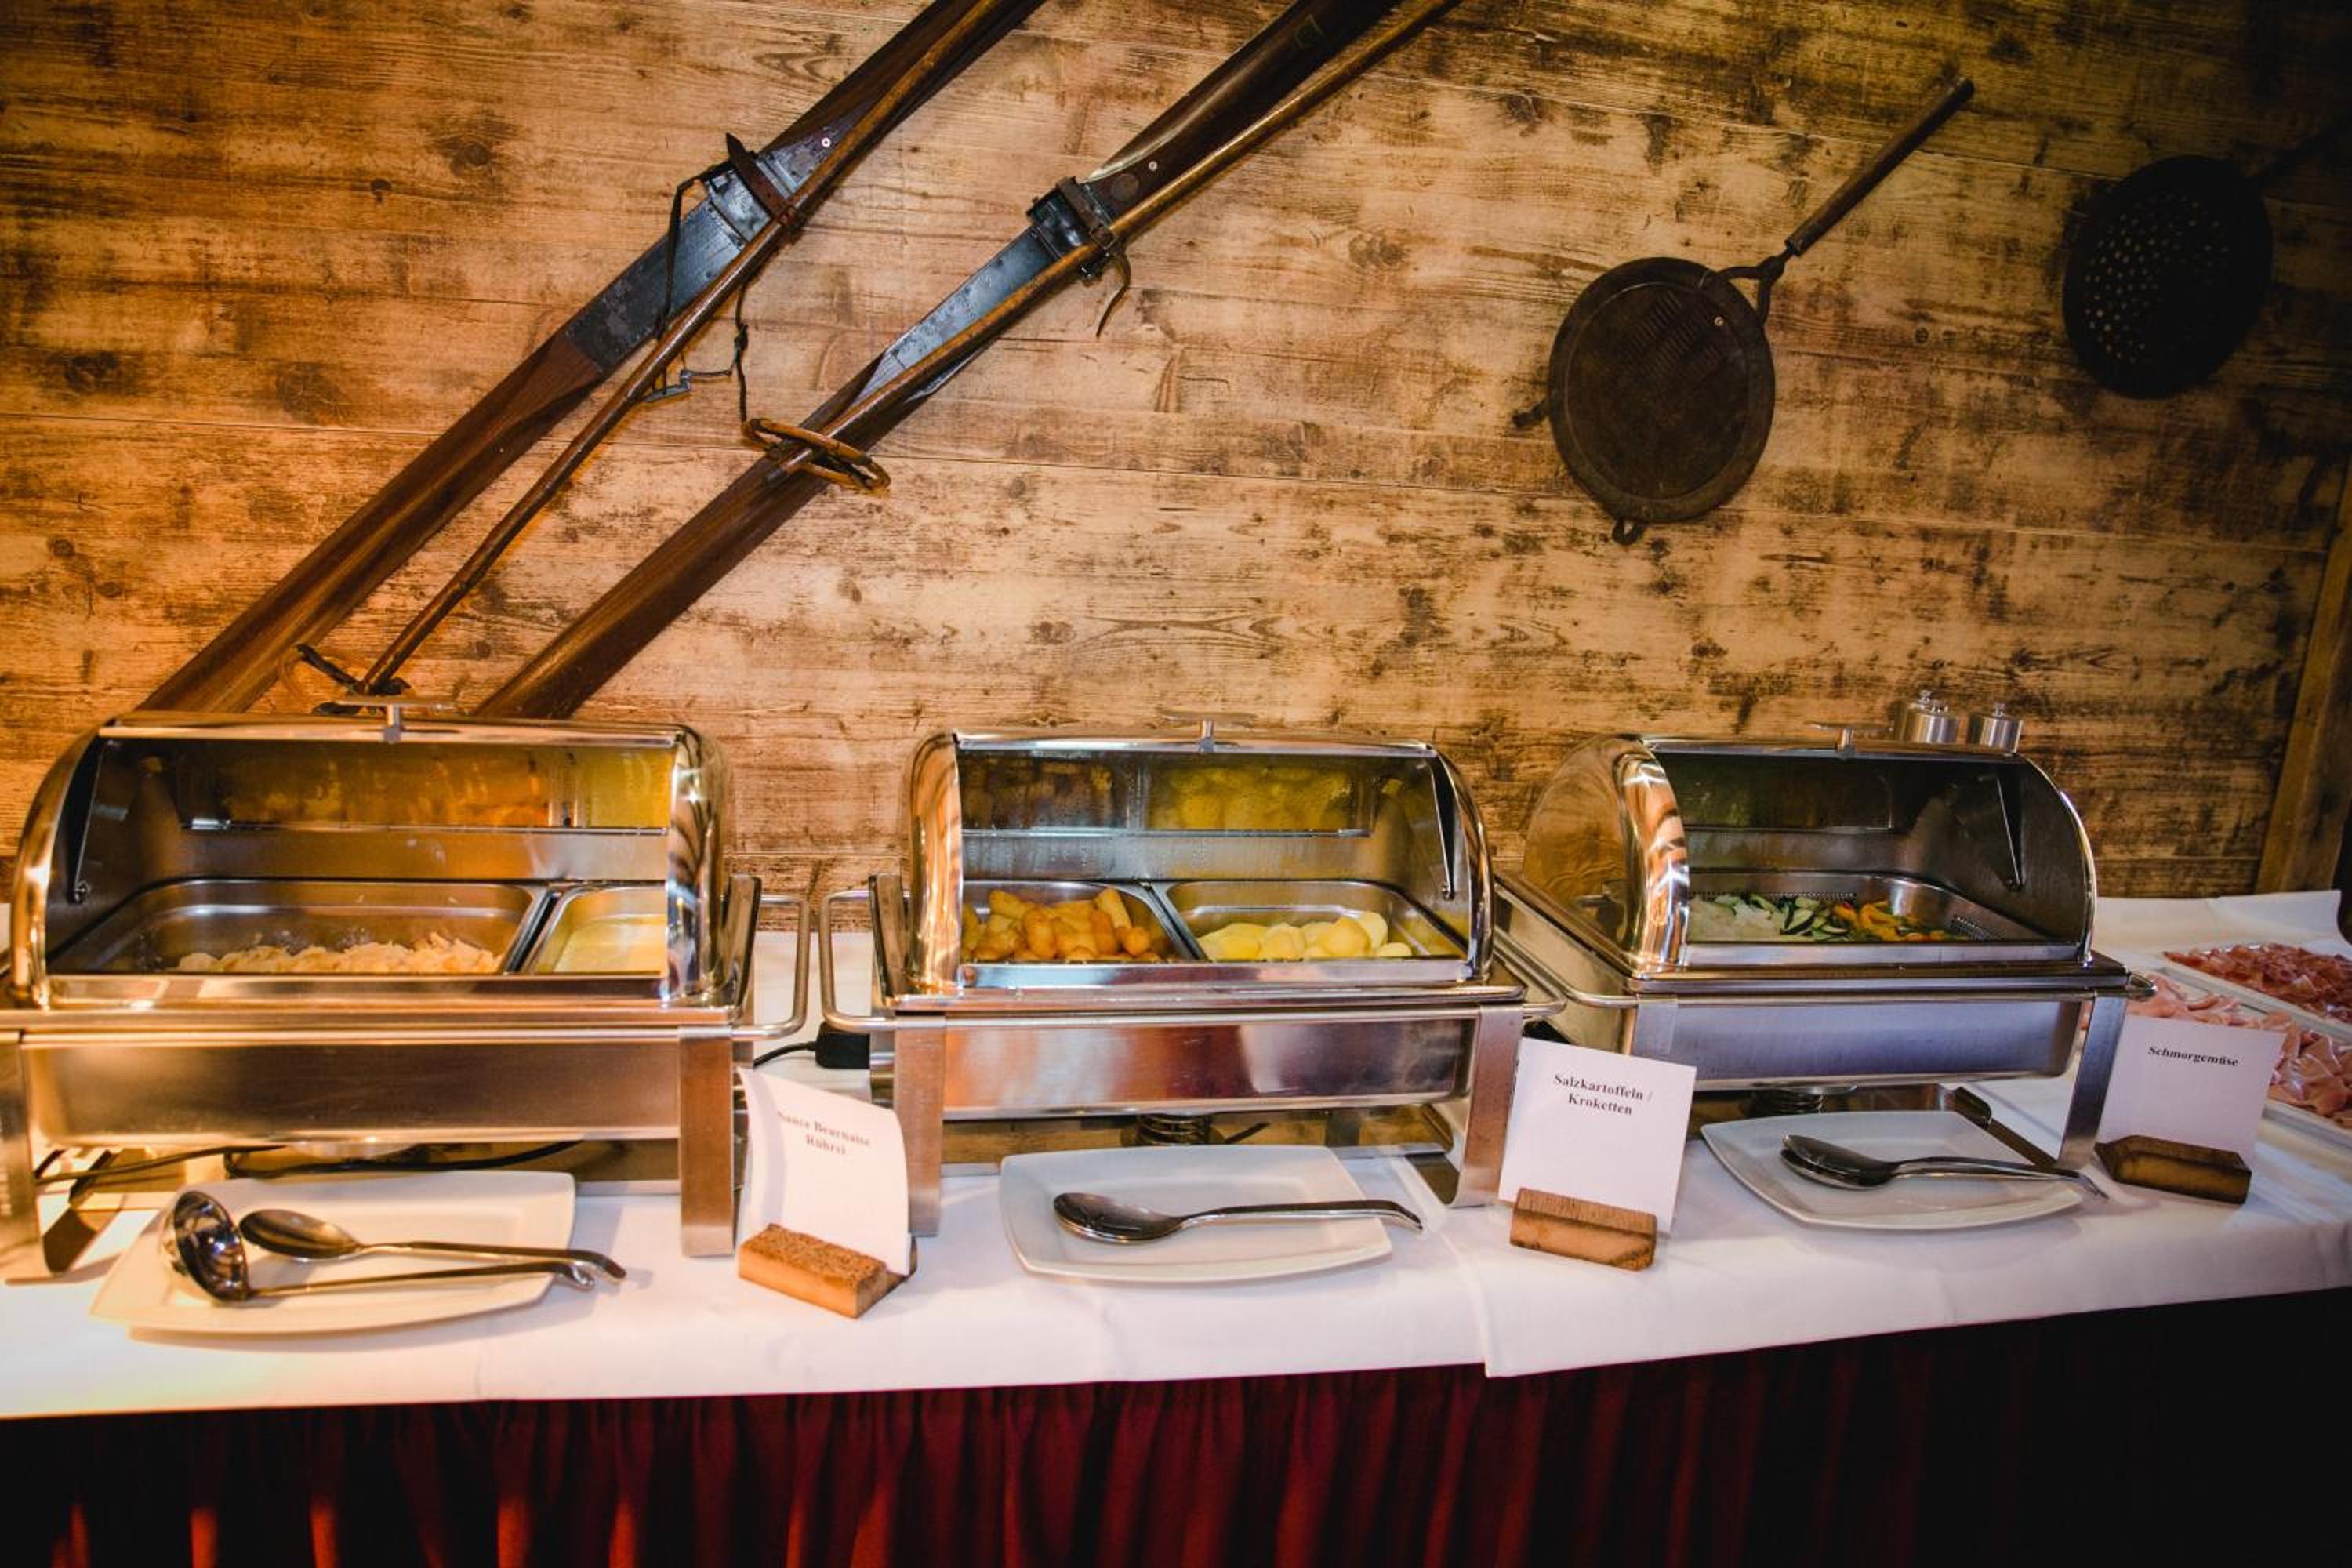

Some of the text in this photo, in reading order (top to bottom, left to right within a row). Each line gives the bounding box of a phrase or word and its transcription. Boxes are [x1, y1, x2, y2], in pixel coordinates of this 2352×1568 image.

[2148, 1047, 2238, 1067] Schmorgemüse
[1554, 1074, 1643, 1100] Salzkartoffeln
[1568, 1093, 1632, 1115] Kroketten
